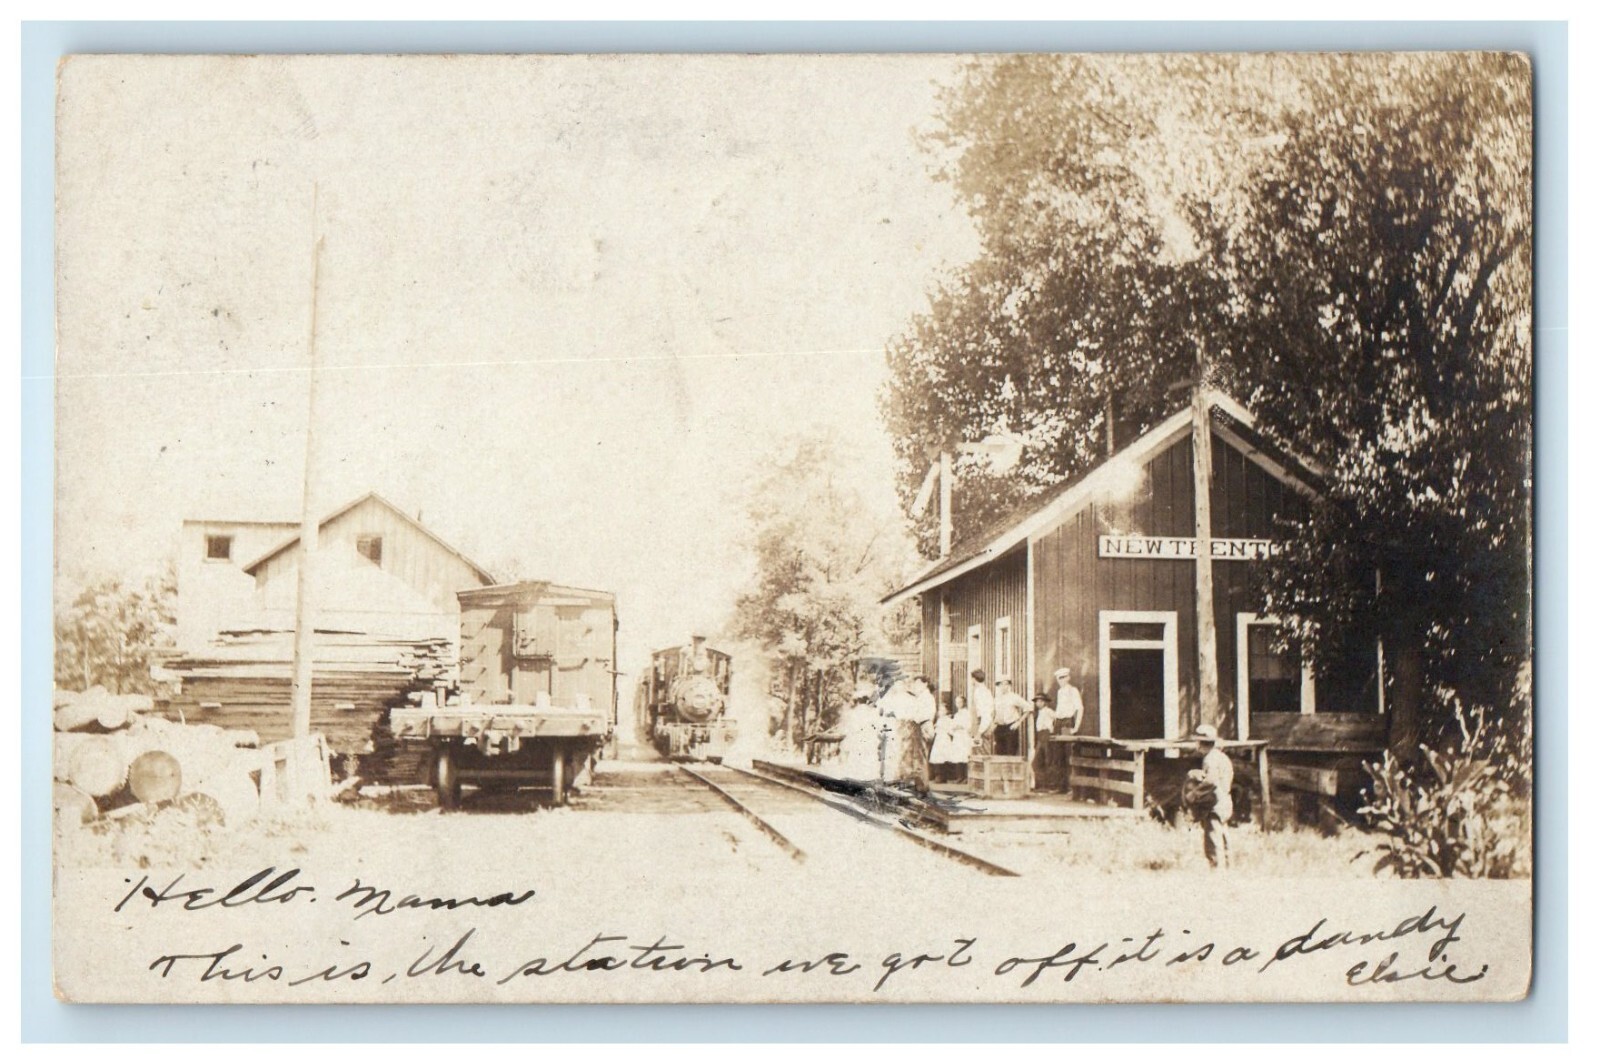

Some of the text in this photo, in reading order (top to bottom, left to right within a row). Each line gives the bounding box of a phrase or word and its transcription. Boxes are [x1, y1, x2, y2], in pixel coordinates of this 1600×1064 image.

[1105, 538, 1286, 557] NEW TENT
[335, 878, 536, 920] Mama
[148, 944, 283, 982] This
[405, 927, 486, 978] the
[497, 931, 744, 985] station
[762, 952, 862, 977] we
[872, 936, 978, 992] got
[1106, 928, 1165, 969] it
[1165, 928, 1216, 967] is
[1221, 947, 1260, 966] a
[1257, 904, 1467, 974] dandy
